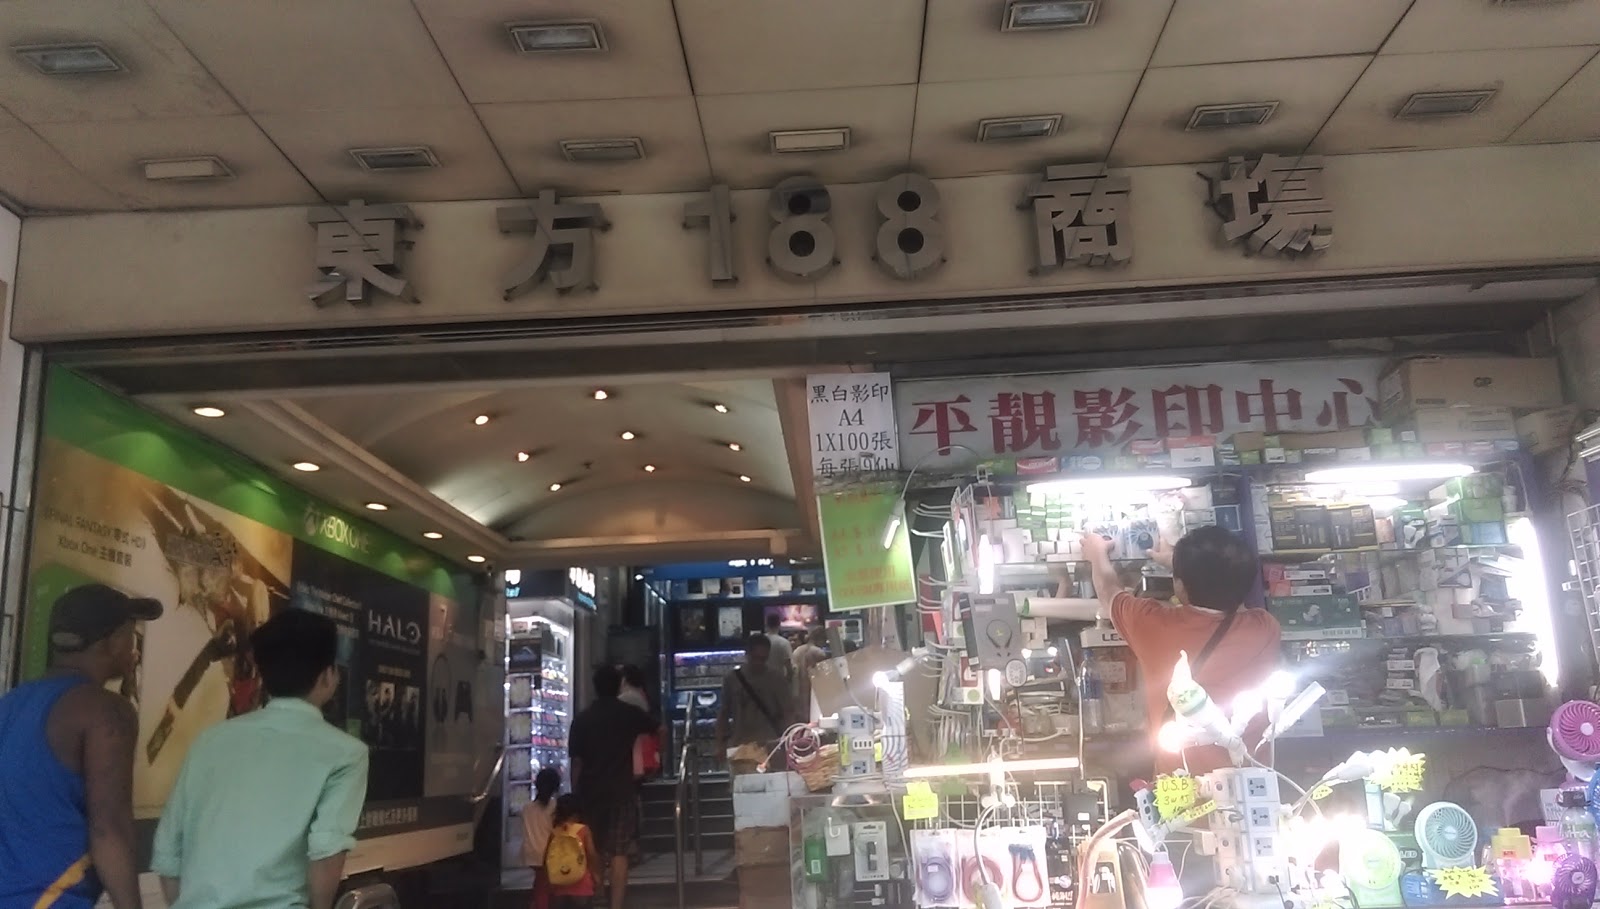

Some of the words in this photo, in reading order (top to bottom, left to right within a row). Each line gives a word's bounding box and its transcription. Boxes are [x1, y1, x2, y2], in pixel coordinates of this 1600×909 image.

[307, 153, 1334, 304] 東方188商場
[810, 382, 889, 404] 黑白影印
[838, 408, 865, 427] A4
[909, 378, 1386, 457] 平靚影印中心
[368, 609, 421, 644] HALO
